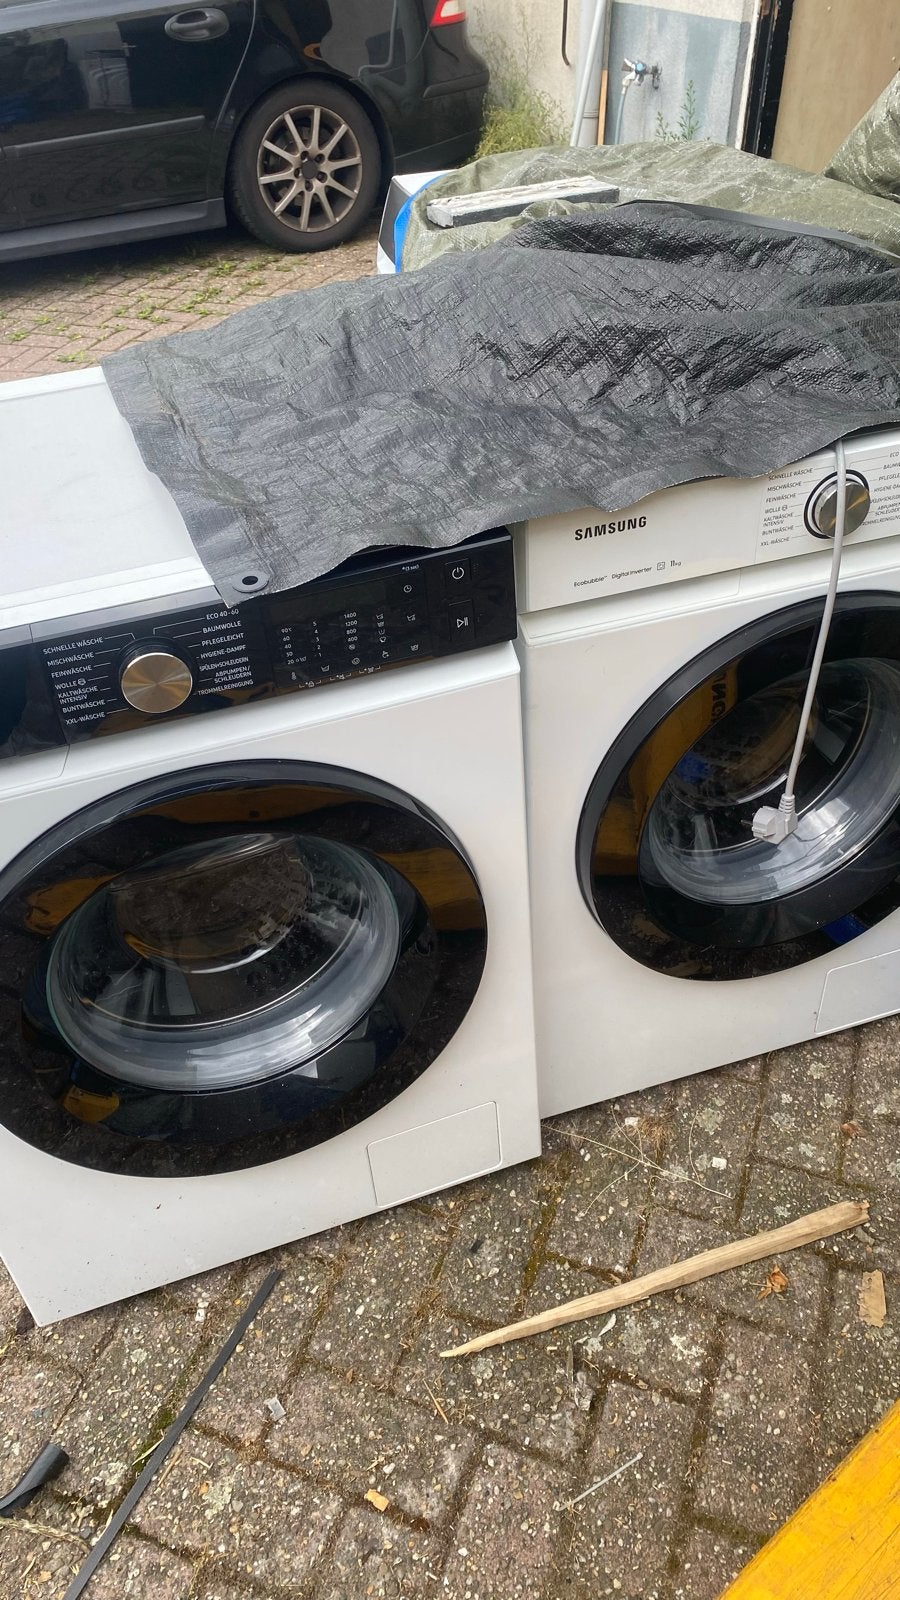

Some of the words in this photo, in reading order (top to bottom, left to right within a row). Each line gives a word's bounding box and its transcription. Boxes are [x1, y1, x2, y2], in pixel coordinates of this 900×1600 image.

[768, 472, 793, 481] SCHNELLE
[767, 481, 802, 492] MISCHWÄSCHE
[766, 493, 796, 503] FEINWÄSCHE
[574, 516, 647, 541] SAMSUNG
[611, 571, 629, 580] Digital
[206, 612, 219, 621] ECO
[202, 620, 242, 634] BAUMWOLLE
[43, 642, 77, 655] SCHNELLE
[76, 636, 104, 648] WÄSCHE
[201, 632, 244, 647] PFLEGELEICHT
[47, 651, 95, 667] MISCHWÄSCHE
[200, 644, 246, 660] HYGIENE-DAMPF
[51, 664, 93, 678] FEINWÄSCHE
[214, 671, 252, 684] SCHLEUDERN
[55, 680, 77, 690] WOLLE
[58, 685, 98, 699] KALTWÄSCHE
[197, 679, 254, 696] TROMMELREINIGUNG
[60, 694, 88, 705] INTENSIV
[62, 699, 106, 713] BUNTWÄSCHE
[65, 711, 106, 725] XXL-WÄSCHE
